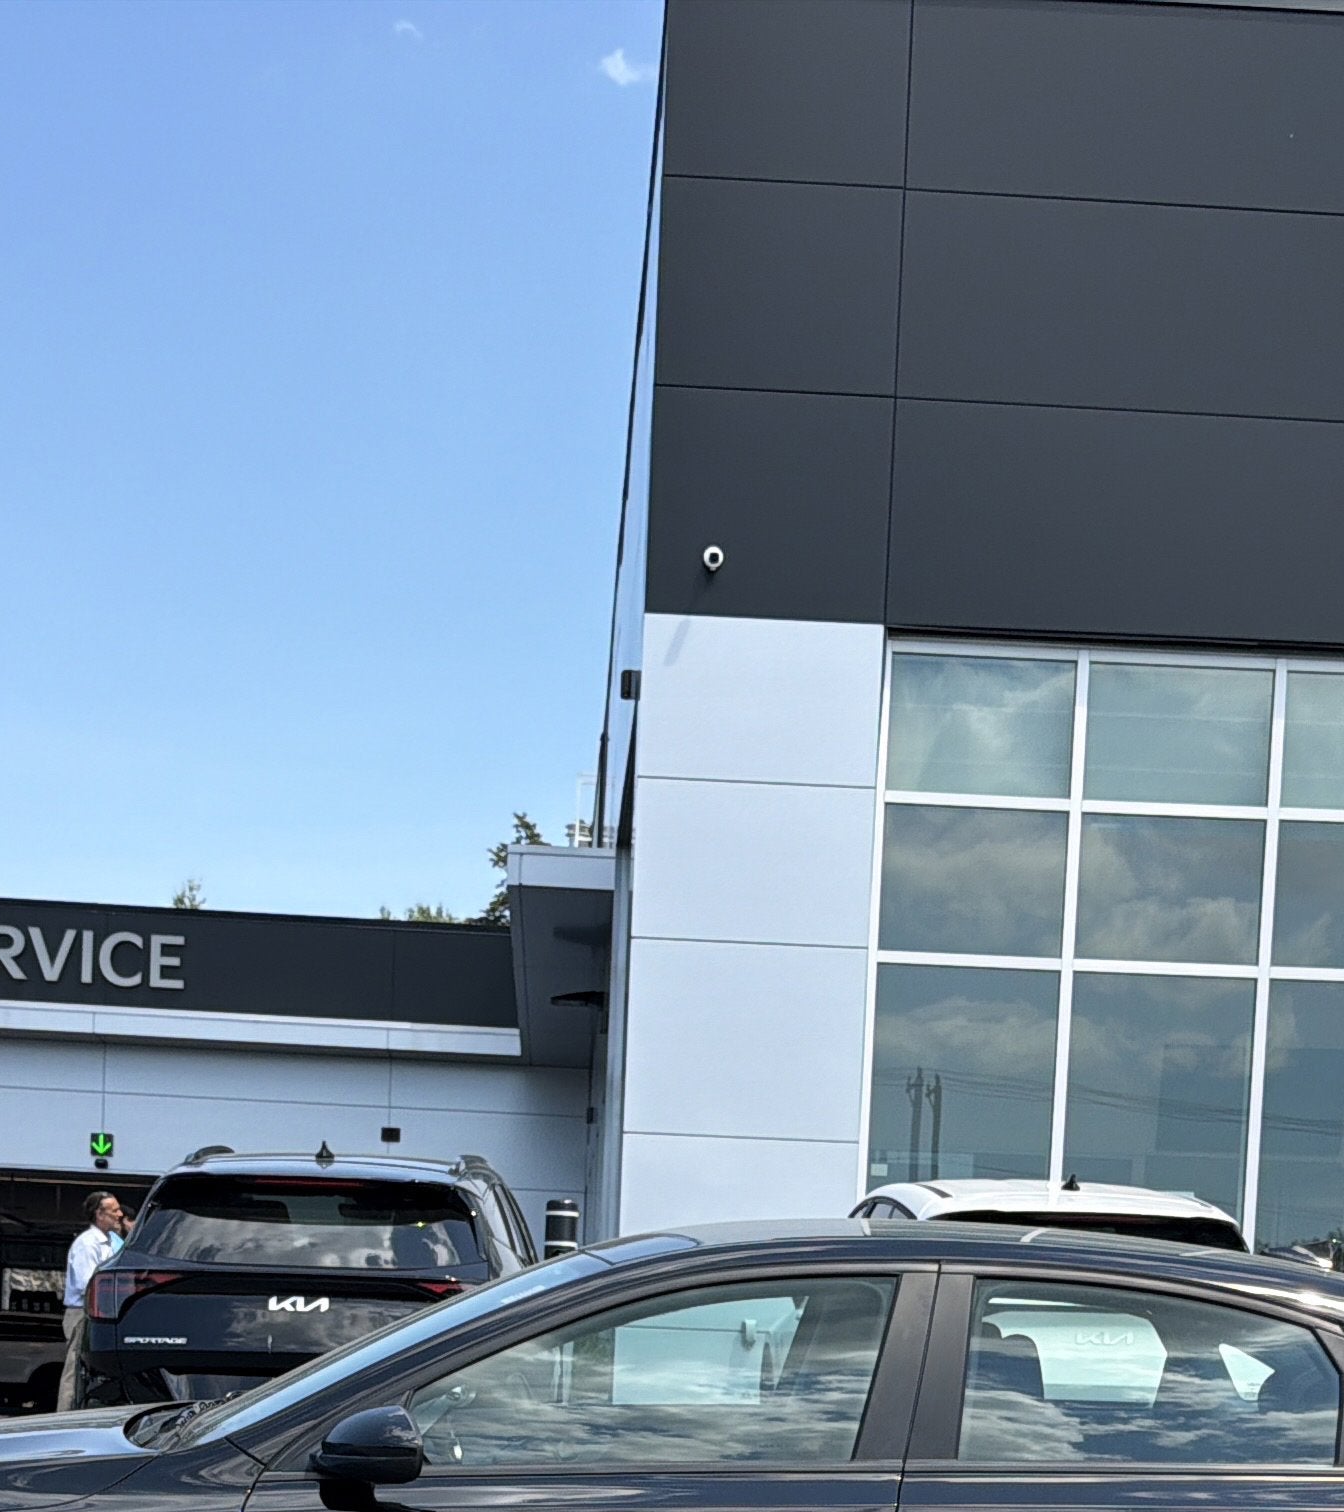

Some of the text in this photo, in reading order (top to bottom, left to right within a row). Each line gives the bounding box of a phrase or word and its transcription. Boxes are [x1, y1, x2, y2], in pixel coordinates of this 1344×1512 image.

[268, 1296, 330, 1313] KIA
[123, 1336, 188, 1345] SPORTAGE
[1075, 1331, 1134, 1345] KIA
